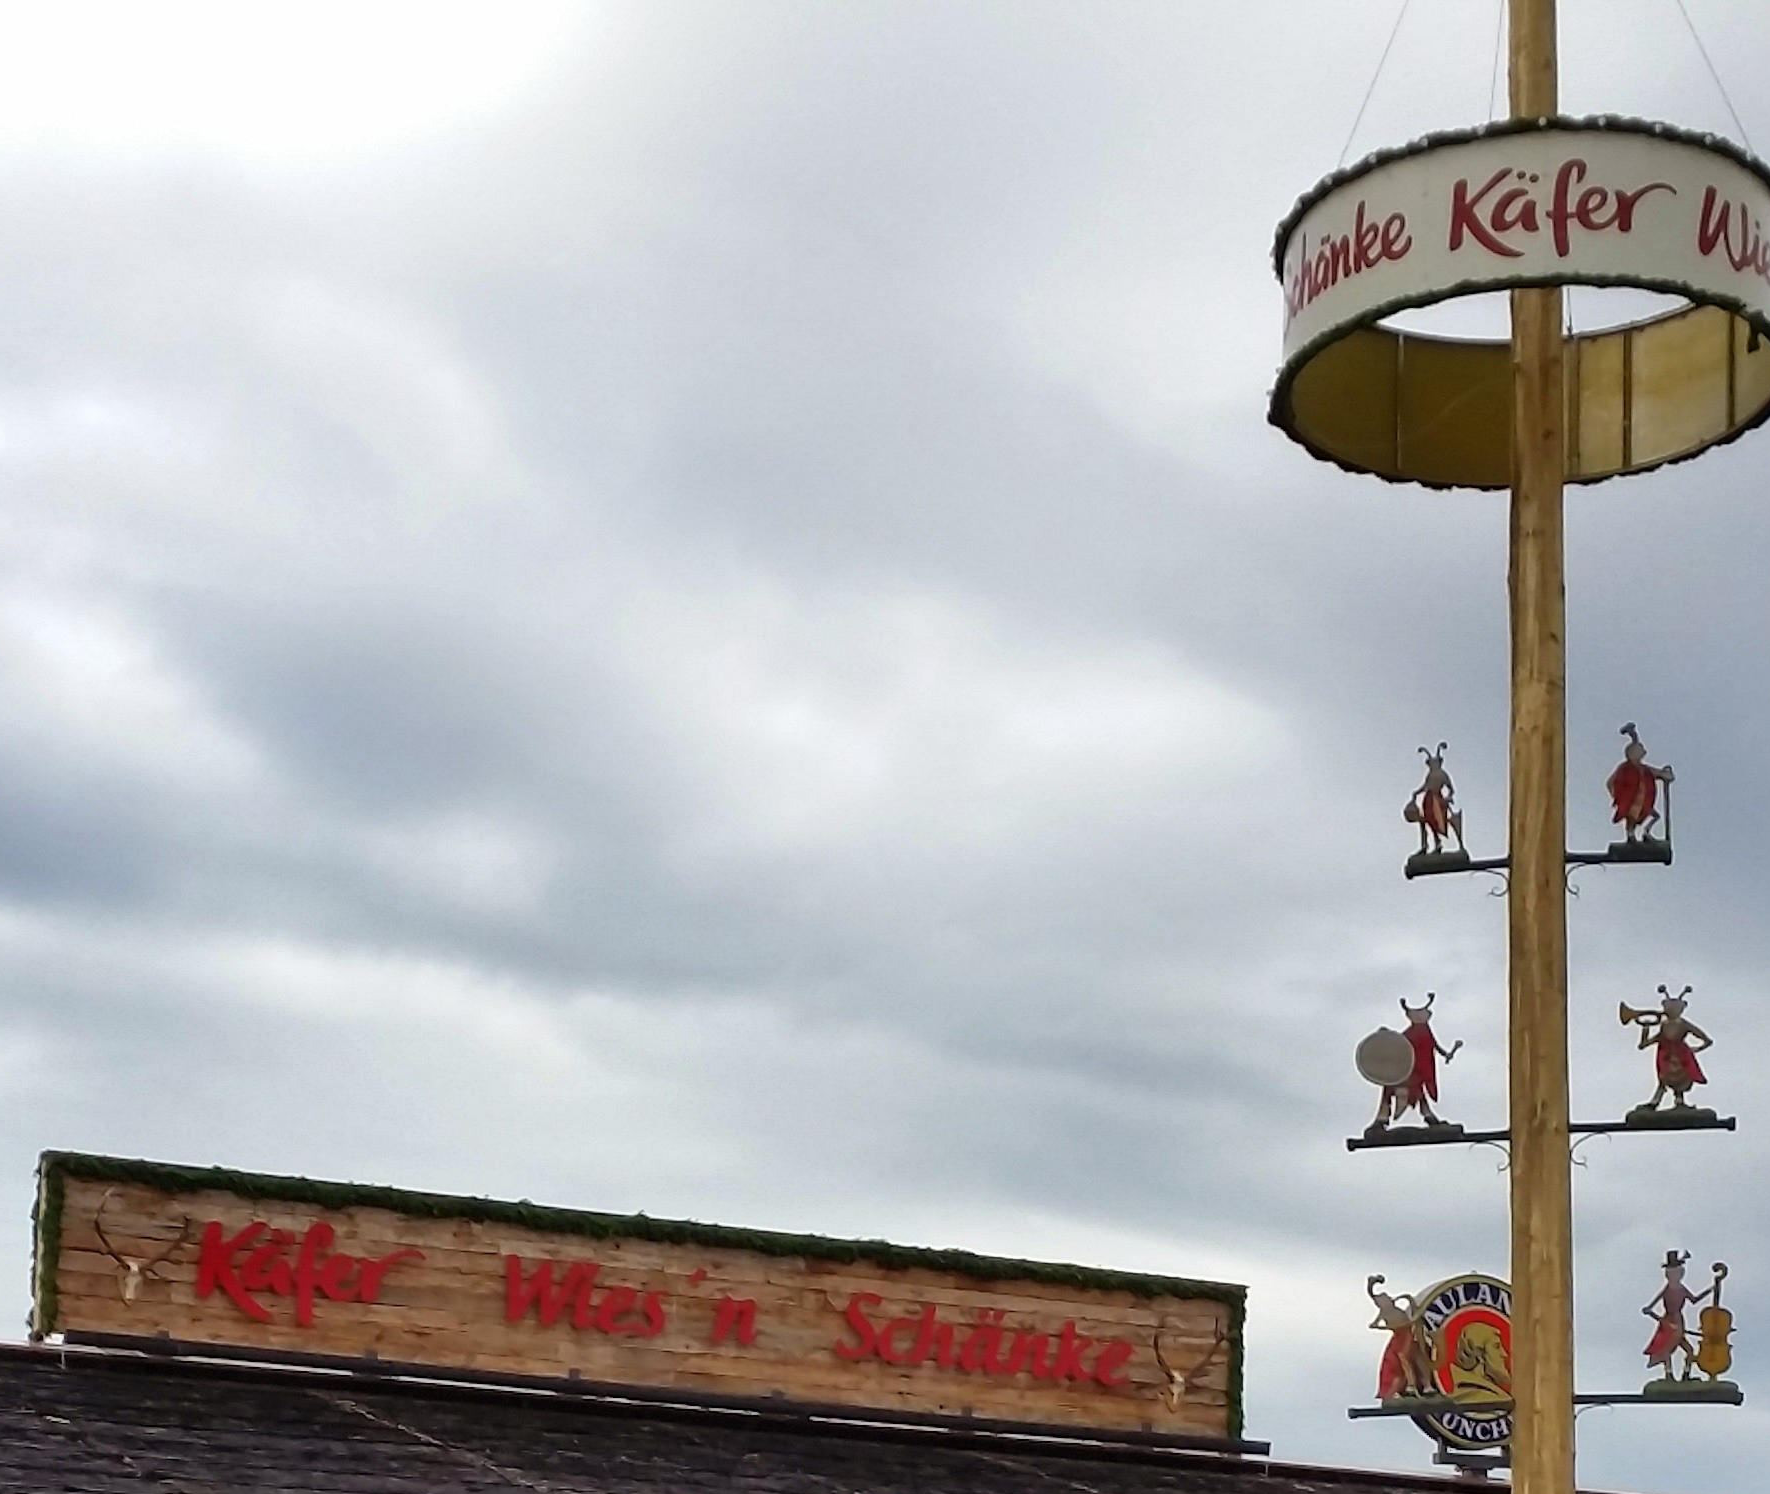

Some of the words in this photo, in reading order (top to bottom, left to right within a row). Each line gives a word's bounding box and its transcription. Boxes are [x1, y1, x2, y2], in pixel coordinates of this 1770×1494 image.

[1449, 158, 1677, 257] Käfer
[196, 1220, 427, 1328] Käfer
[834, 1291, 1136, 1387] Schänke
